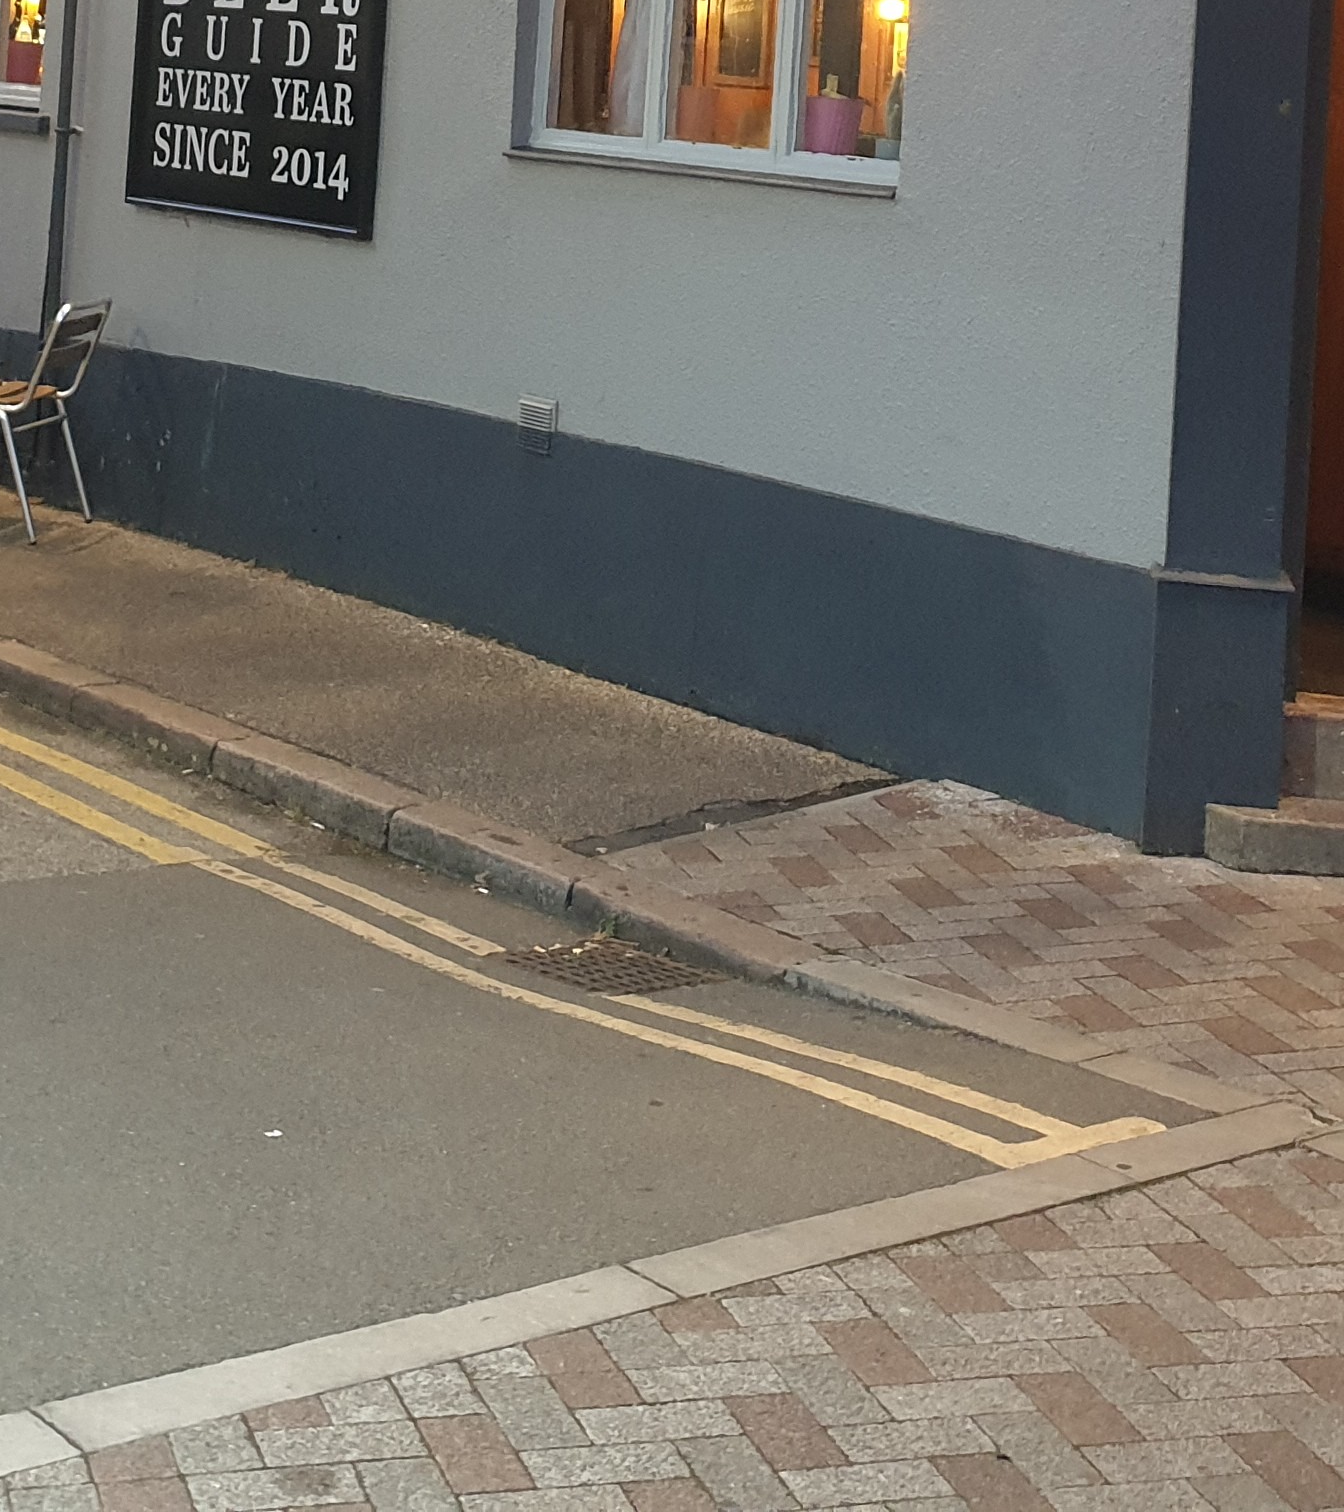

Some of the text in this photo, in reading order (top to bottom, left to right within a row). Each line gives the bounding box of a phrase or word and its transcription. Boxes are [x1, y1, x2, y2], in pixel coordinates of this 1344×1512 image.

[161, 12, 357, 72] GUIDE
[155, 66, 355, 127] EVERY YEAR
[153, 121, 349, 202] SINCE 2014
